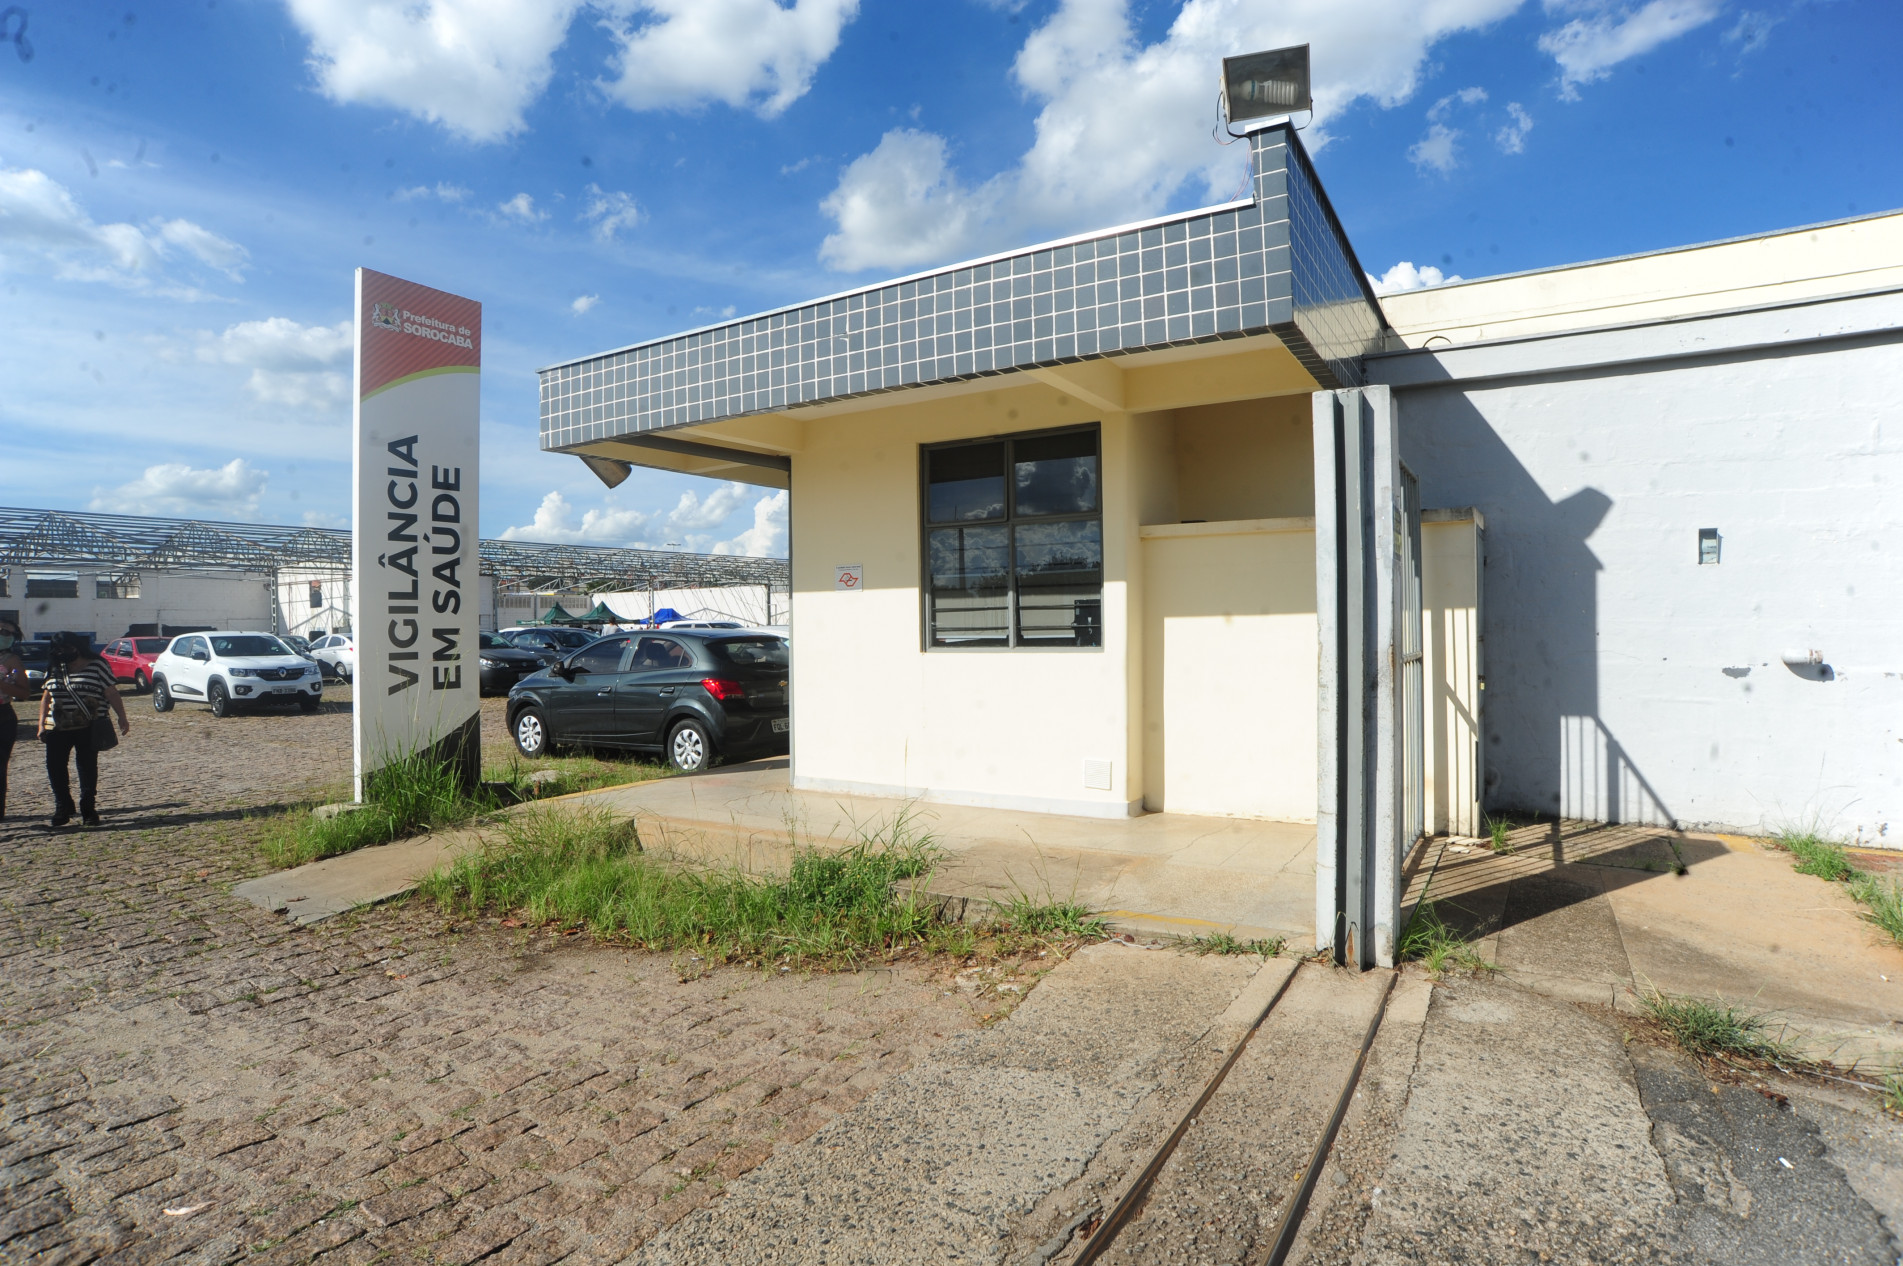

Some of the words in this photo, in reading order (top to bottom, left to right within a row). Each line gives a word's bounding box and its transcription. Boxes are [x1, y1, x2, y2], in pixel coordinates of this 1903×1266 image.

[403, 310, 456, 332] Prefeitura
[458, 326, 471, 336] de
[403, 322, 473, 350] SOROCABA
[378, 434, 419, 696] VIGILÂNCIA
[423, 465, 461, 615] SAÚDE
[432, 627, 461, 691] EM
